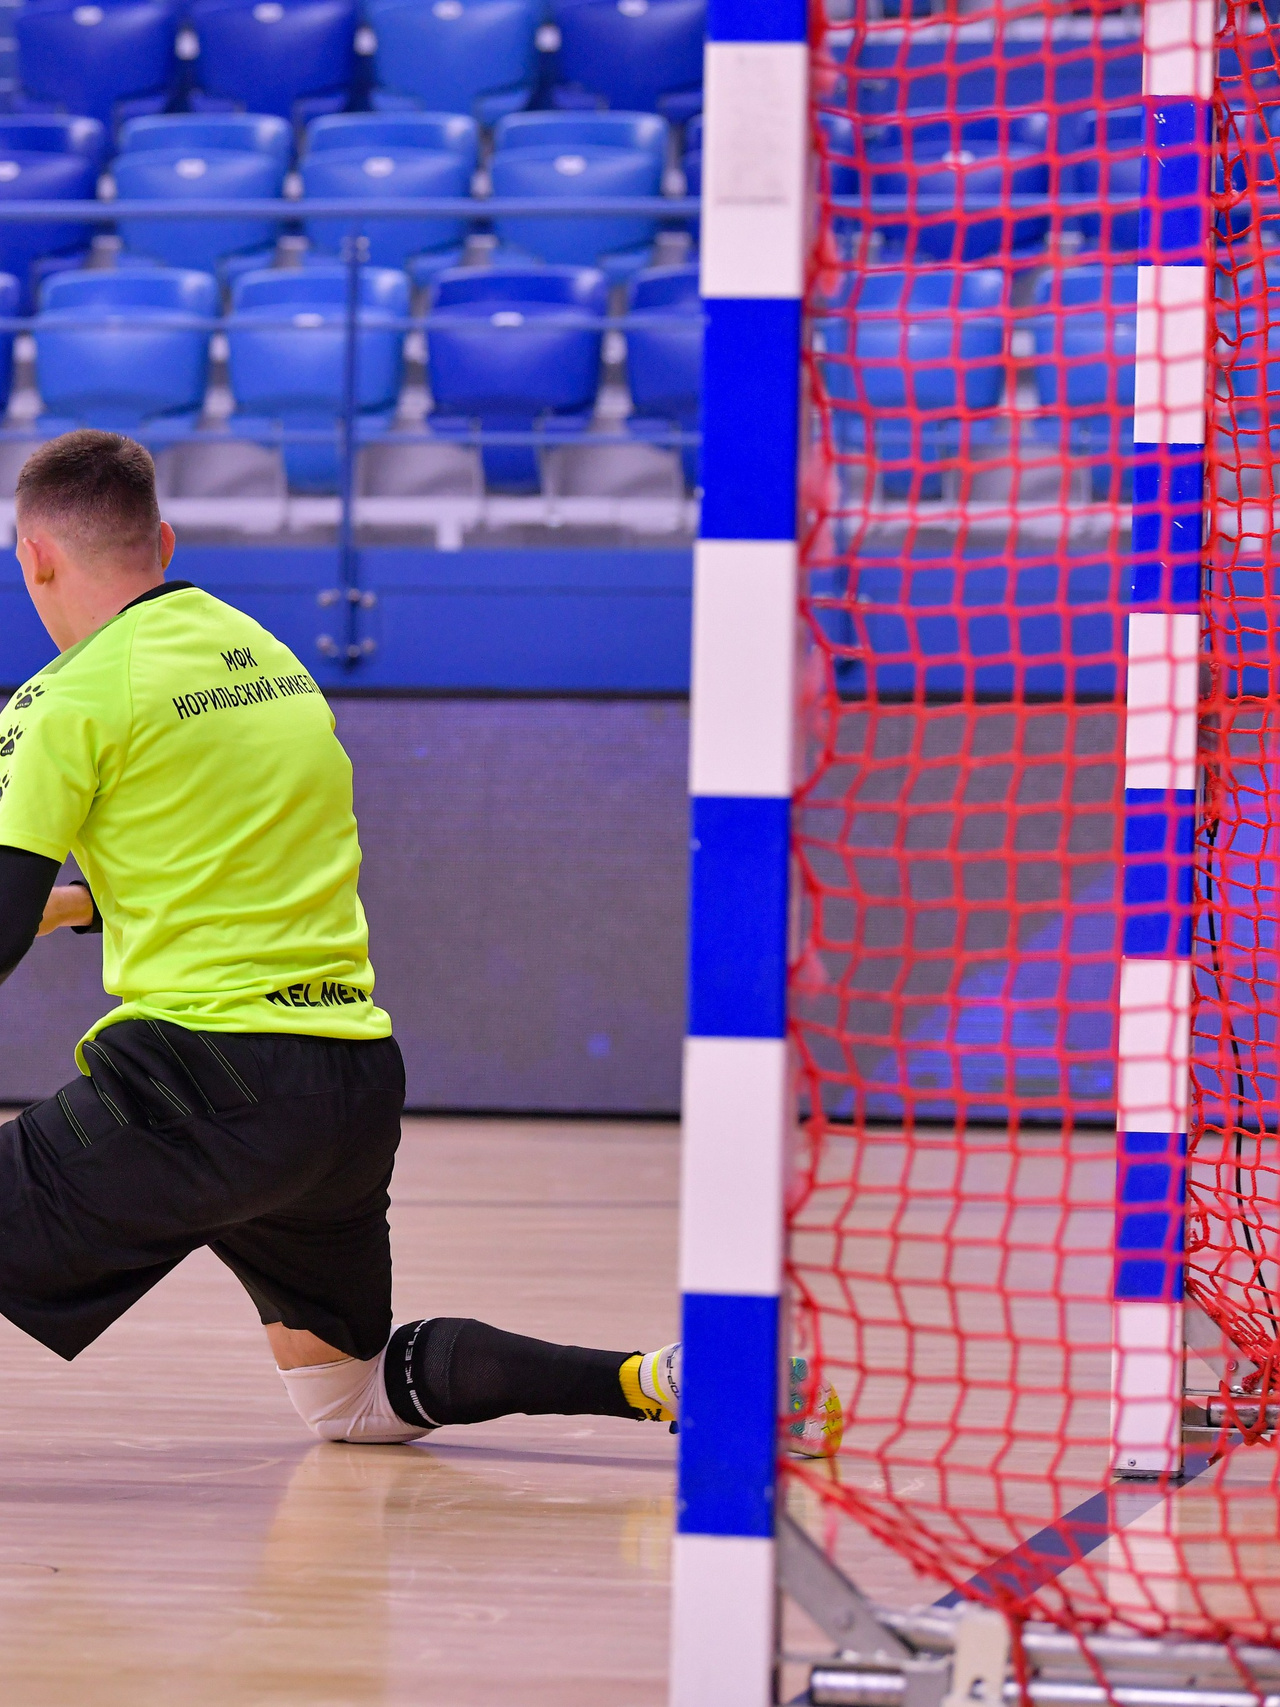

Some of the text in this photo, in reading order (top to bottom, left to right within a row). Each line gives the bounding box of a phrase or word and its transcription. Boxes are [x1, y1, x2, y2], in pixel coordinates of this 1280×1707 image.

[221, 647, 258, 671] МФК
[172, 674, 322, 720] НОРИЛЬСКИЙ НИКЕЛ
